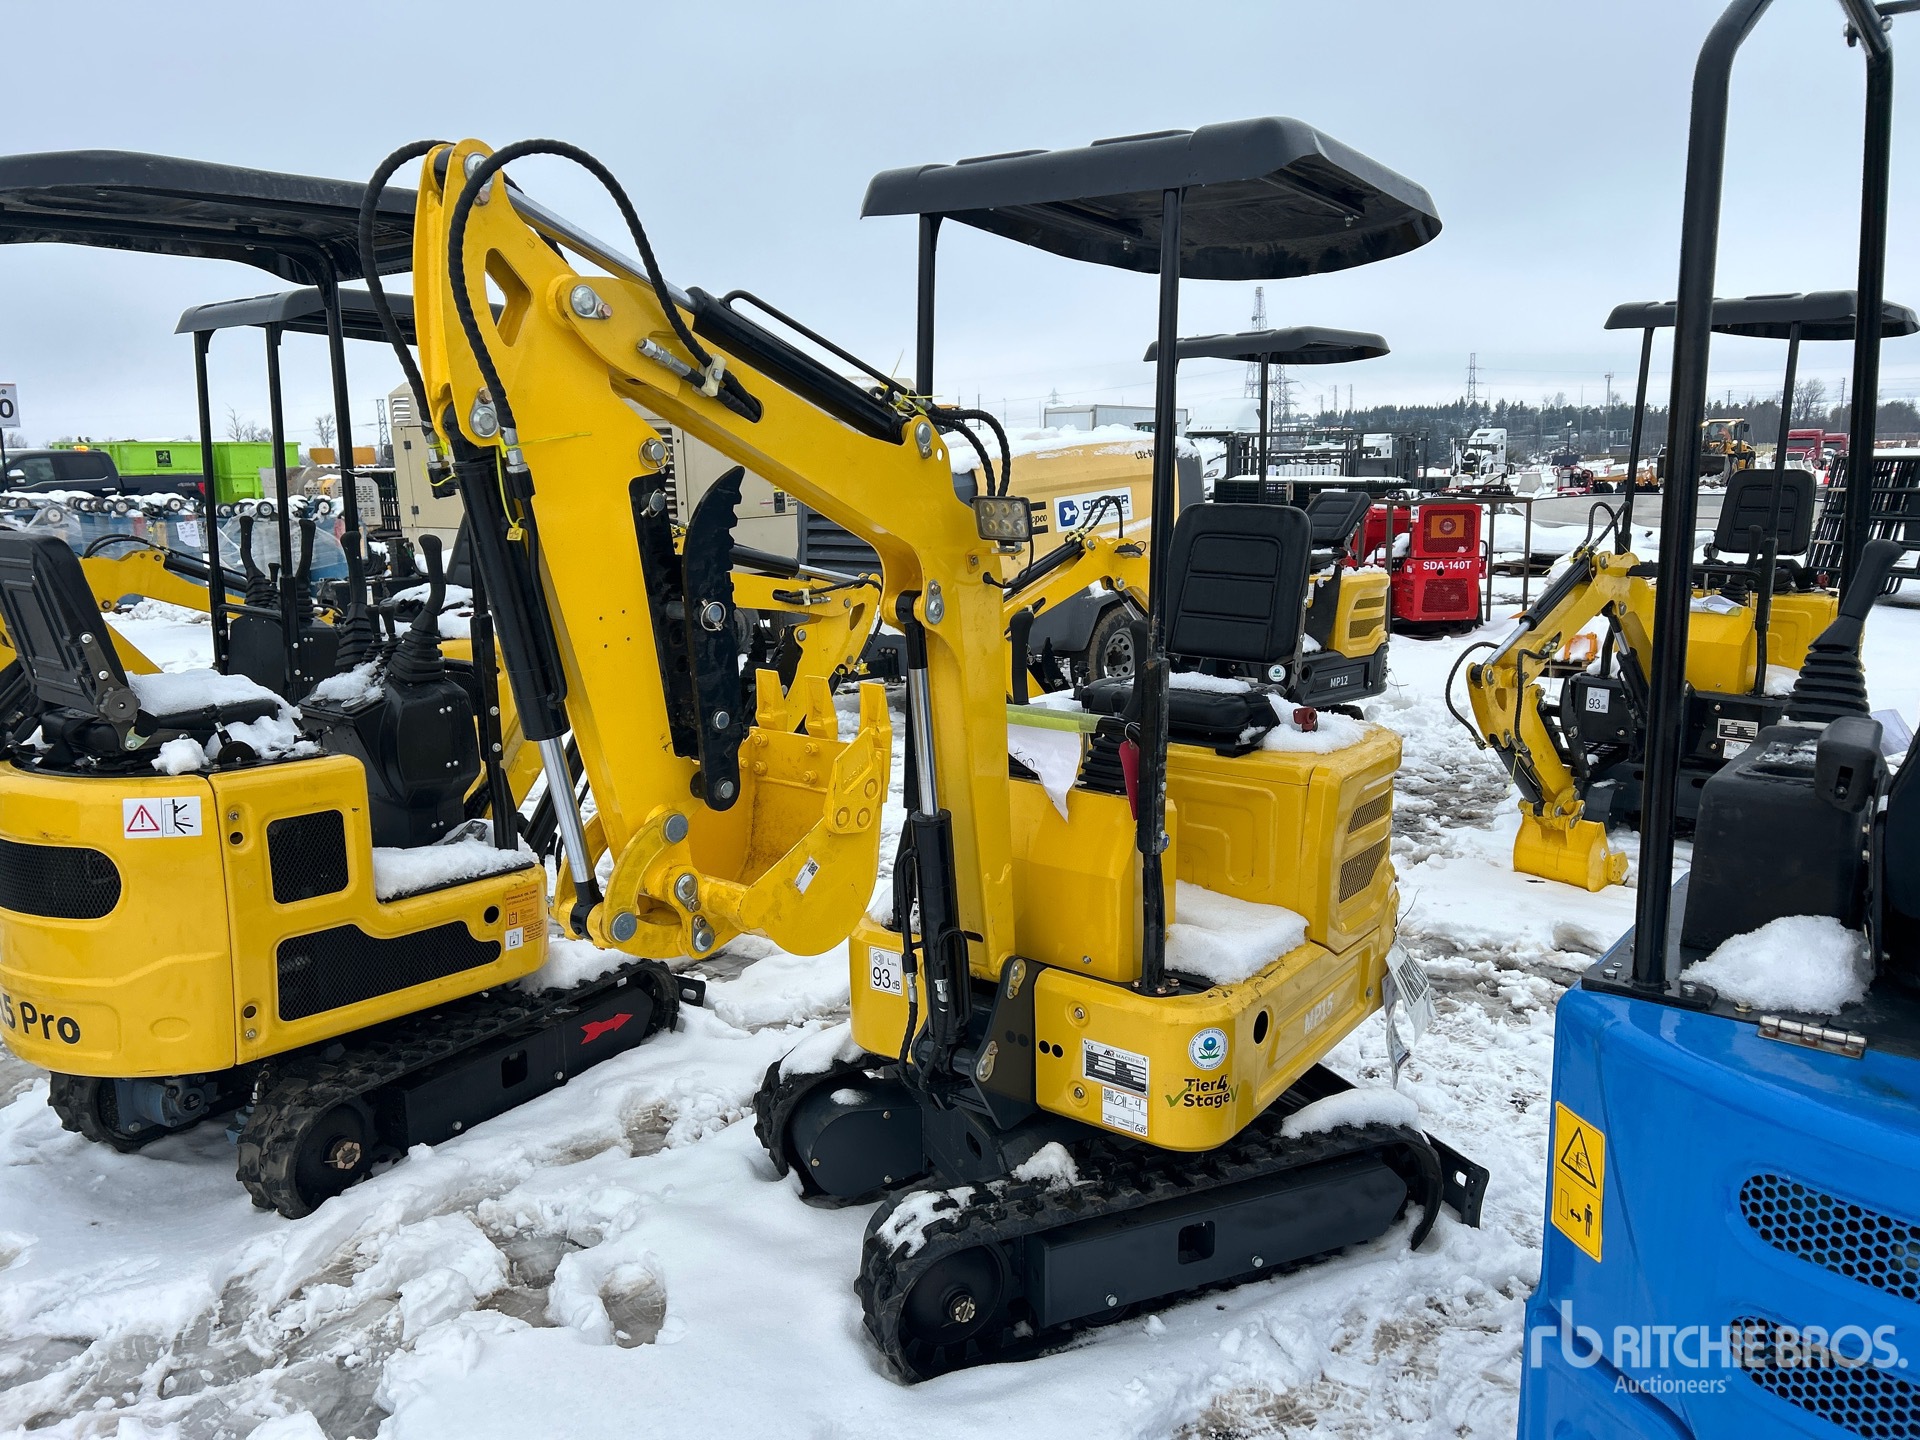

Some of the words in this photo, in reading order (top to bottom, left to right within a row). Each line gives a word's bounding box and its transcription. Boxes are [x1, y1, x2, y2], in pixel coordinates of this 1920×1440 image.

[1423, 560, 1472, 571] SDA-140T
[1330, 675, 1349, 688] MP12
[1589, 697, 1601, 710] 93
[873, 966, 891, 989] 93
[892, 980, 900, 990] dB
[20, 1001, 81, 1045] Pro
[1183, 1092, 1230, 1108] Stage
